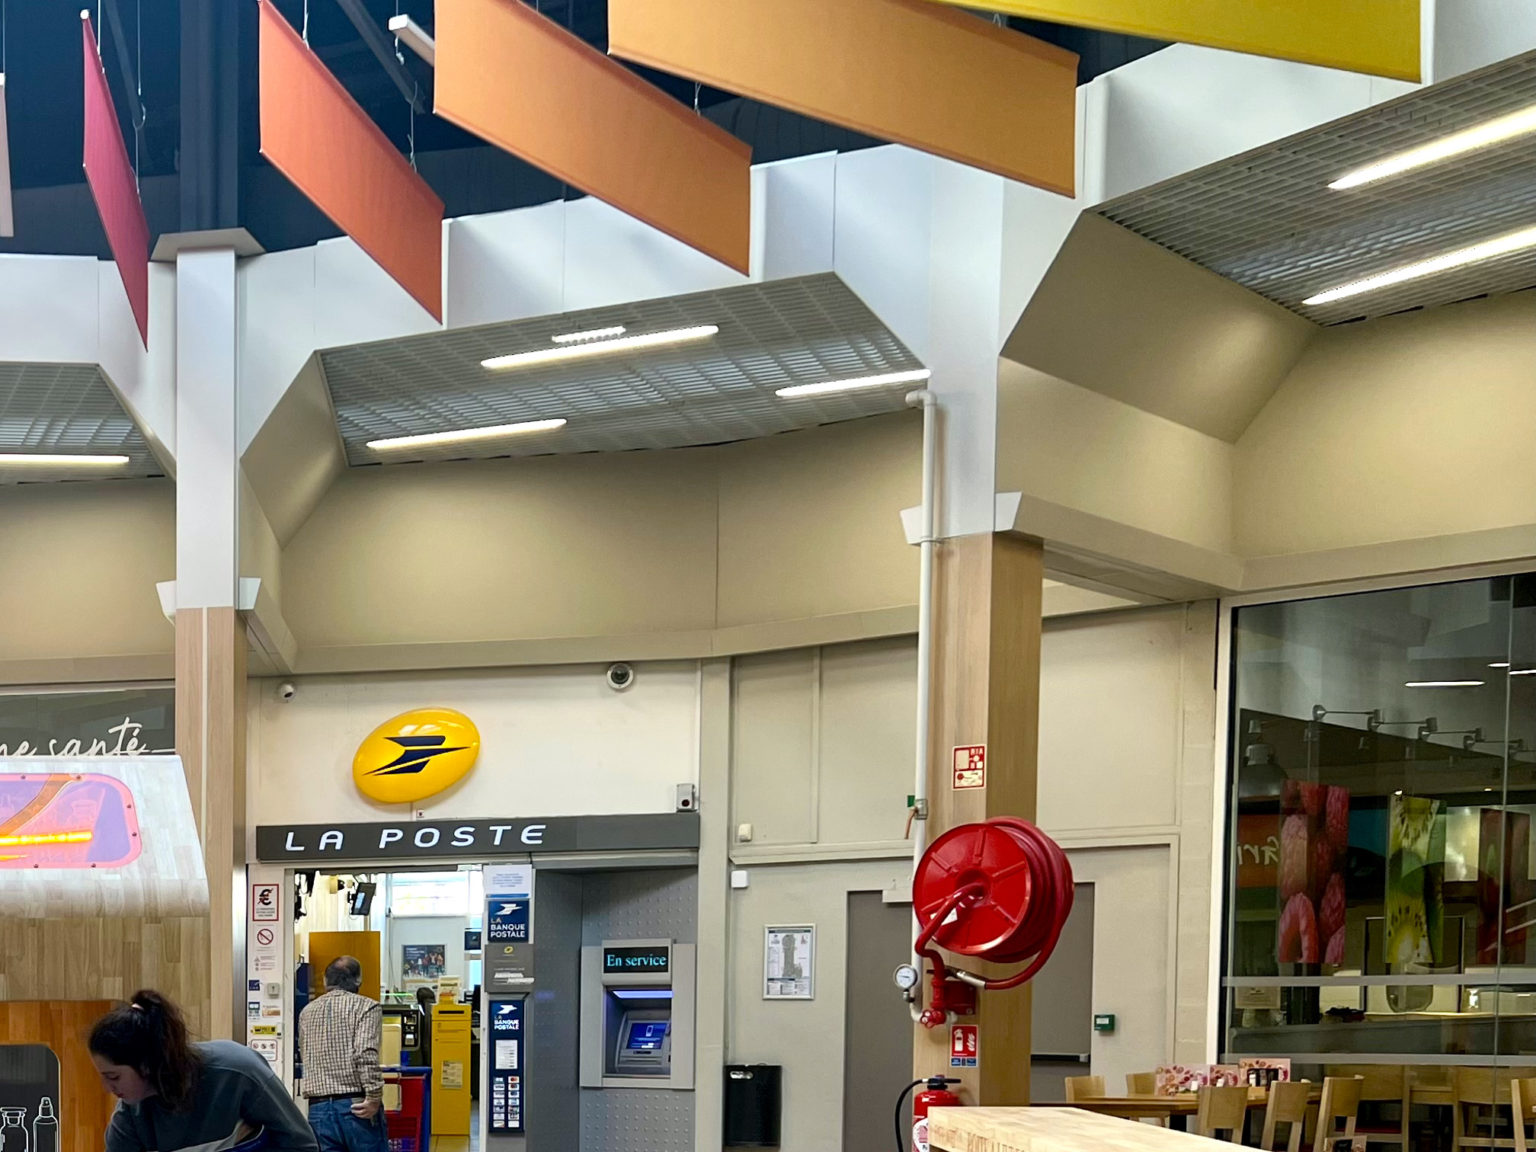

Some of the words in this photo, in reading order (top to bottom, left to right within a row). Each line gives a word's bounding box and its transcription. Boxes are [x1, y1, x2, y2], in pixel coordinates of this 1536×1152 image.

[49, 716, 147, 756] santé
[285, 830, 344, 851] LA
[379, 825, 546, 849] POSTE
[490, 923, 525, 931] BANQUE
[490, 930, 525, 938] POSTALE
[607, 954, 622, 967] En
[625, 953, 667, 967] service
